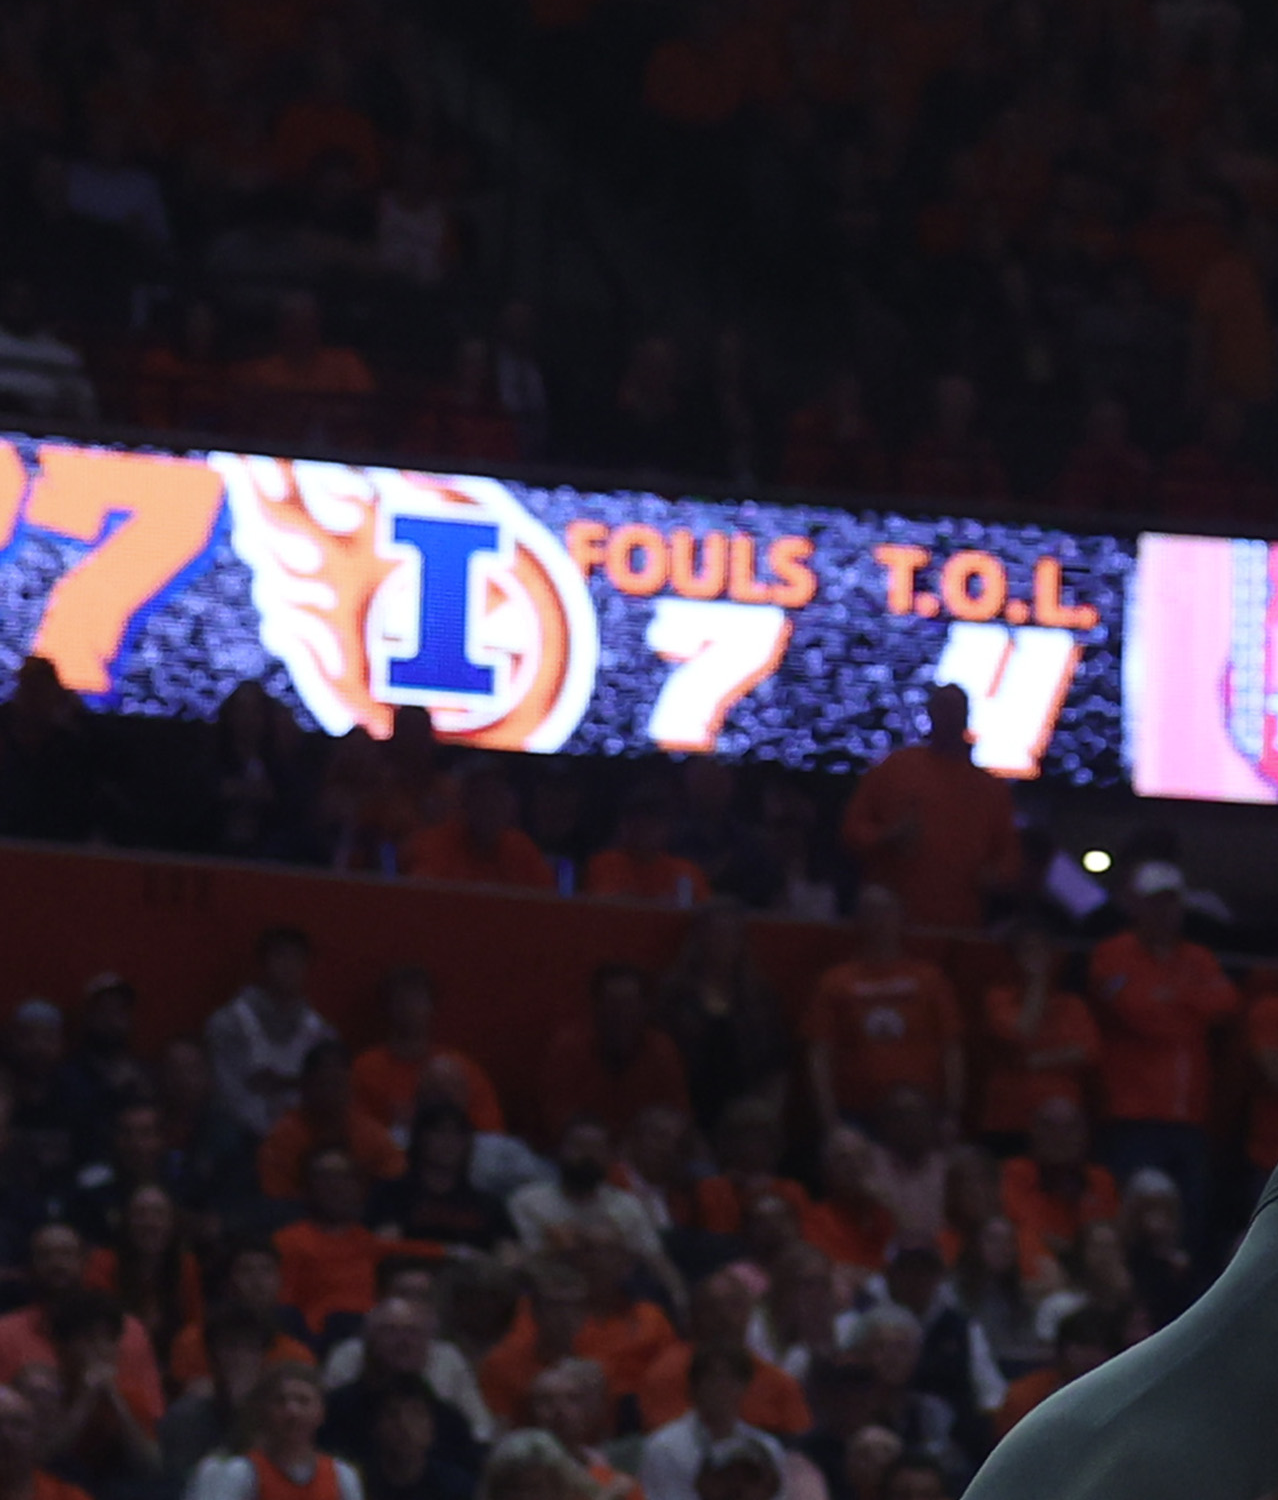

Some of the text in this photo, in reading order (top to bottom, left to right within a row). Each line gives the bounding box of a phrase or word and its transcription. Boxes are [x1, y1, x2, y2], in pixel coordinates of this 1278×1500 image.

[0, 447, 226, 695] 7
[570, 520, 817, 608] FOULS
[874, 543, 1098, 631] T.O.L.
[646, 598, 791, 752] 7
